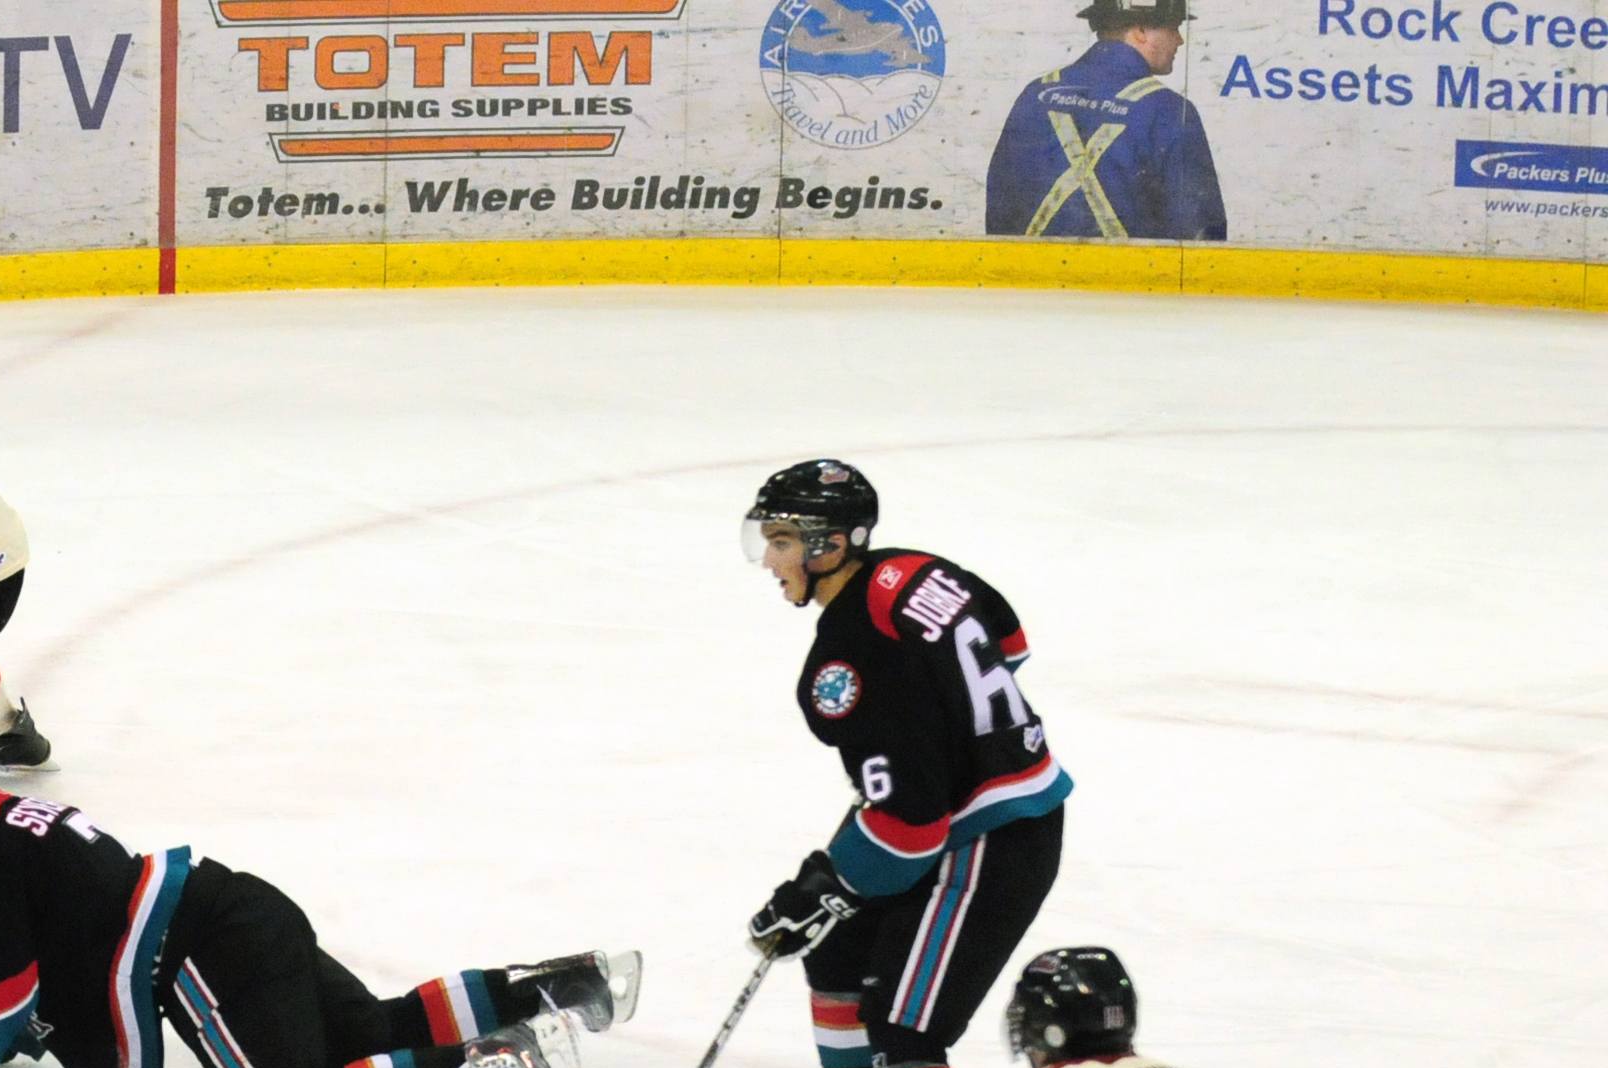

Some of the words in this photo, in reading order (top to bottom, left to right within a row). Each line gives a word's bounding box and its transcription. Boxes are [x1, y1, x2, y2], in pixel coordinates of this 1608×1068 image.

[1318, 0, 1462, 43] Rock
[1481, 0, 1608, 51] Cree
[238, 31, 652, 92] TOTEM
[1219, 54, 1414, 107] Assets
[266, 99, 440, 122] BUILDING
[451, 97, 633, 118] SUPPLIES
[771, 82, 833, 140] Travel
[835, 124, 878, 145] and
[884, 84, 933, 136] More
[1049, 92, 1096, 110] Packers
[1100, 101, 1128, 115] Plus
[205, 186, 387, 219] Totem...
[405, 177, 557, 214] Where
[571, 174, 760, 220] Building
[776, 175, 943, 219] Begins.
[1494, 163, 1570, 183] Packers
[1575, 166, 1608, 185] Plu
[862, 754, 893, 801] 6
